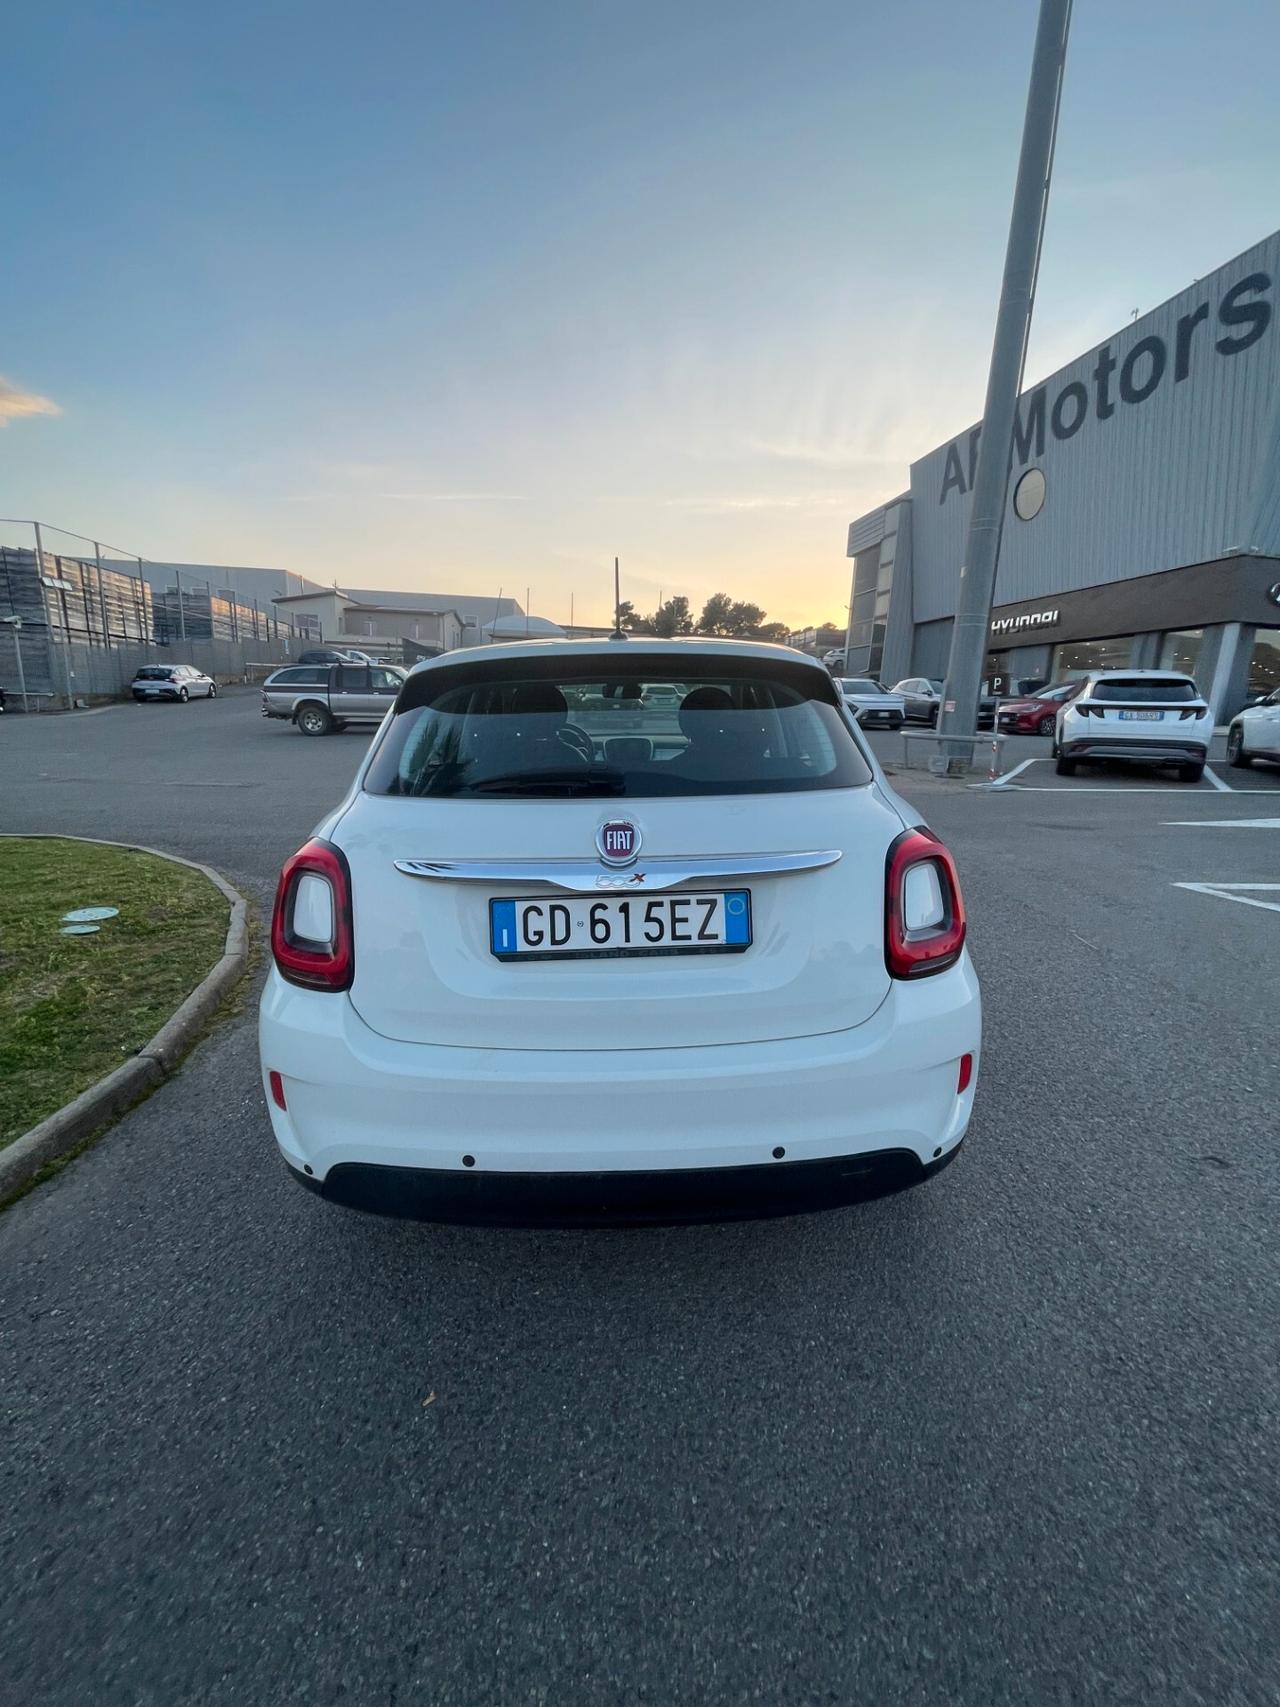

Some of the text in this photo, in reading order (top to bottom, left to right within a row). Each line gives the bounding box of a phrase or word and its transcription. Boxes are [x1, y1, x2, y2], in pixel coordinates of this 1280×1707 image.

[1011, 272, 1272, 467] Motors
[994, 677, 1002, 689] P
[606, 831, 632, 850] FIAT
[522, 904, 571, 946] GD
[589, 899, 719, 944] 615EZ
